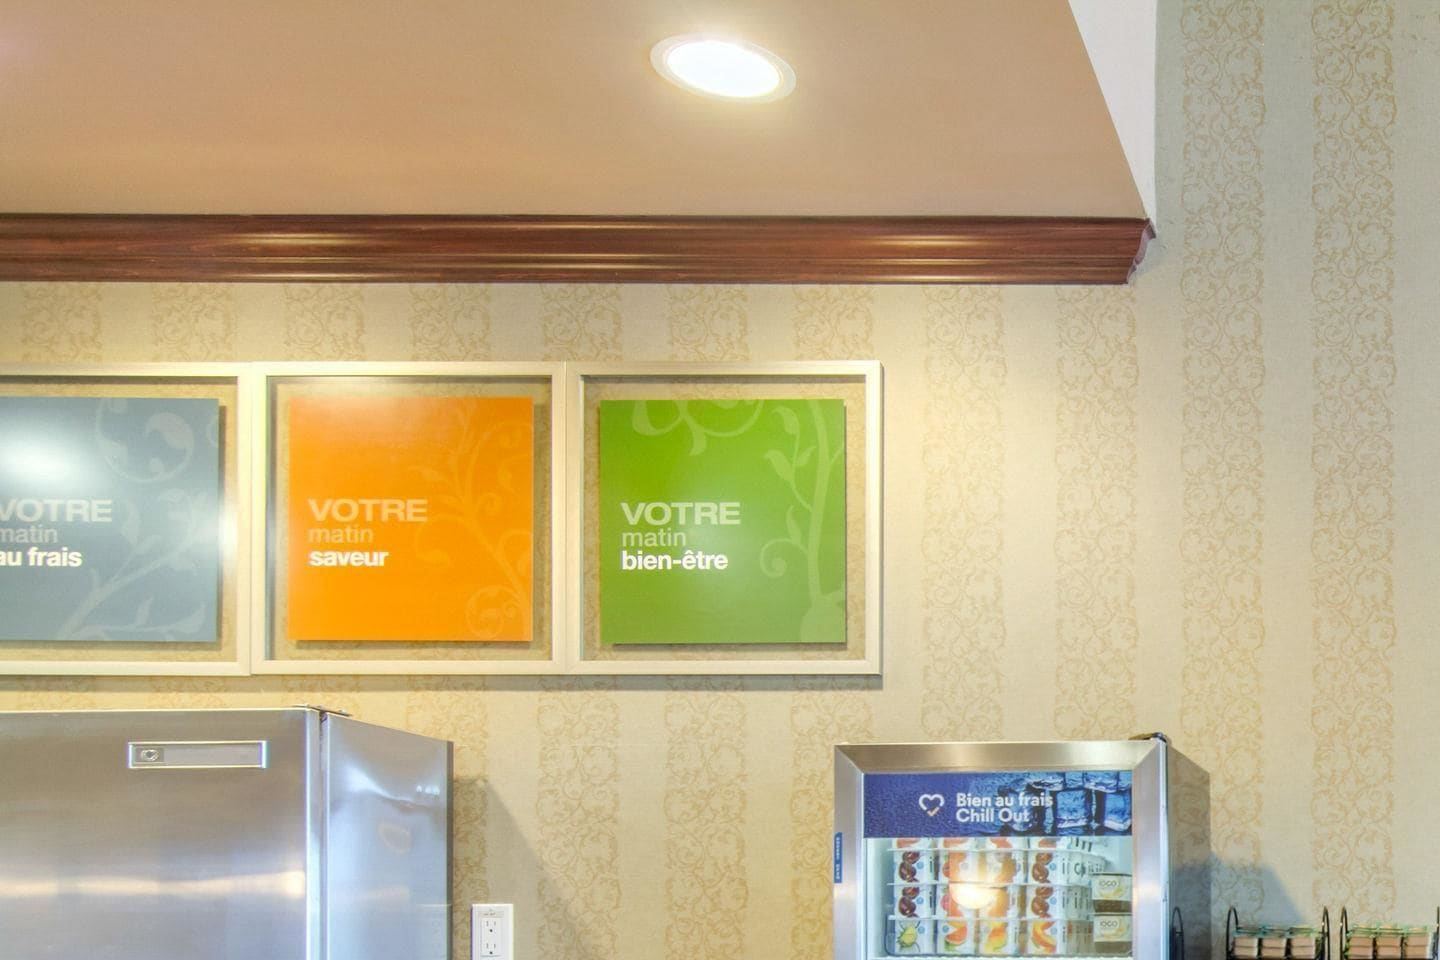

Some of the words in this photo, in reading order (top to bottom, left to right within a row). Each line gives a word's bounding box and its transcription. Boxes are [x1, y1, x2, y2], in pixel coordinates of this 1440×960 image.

[0, 499, 113, 522] VOTRE
[307, 498, 428, 522] VOTRE
[620, 502, 741, 526] VOTRE
[0, 524, 59, 544] matin
[308, 525, 374, 544] matin
[622, 528, 687, 547] matin
[27, 546, 83, 567] frais
[309, 550, 389, 567] saveur
[622, 549, 729, 570] bien-être
[956, 792, 992, 807] Bien
[995, 795, 1014, 807] au
[1018, 791, 1054, 807] frais
[956, 808, 995, 822] Chill
[998, 807, 1030, 822] Out
